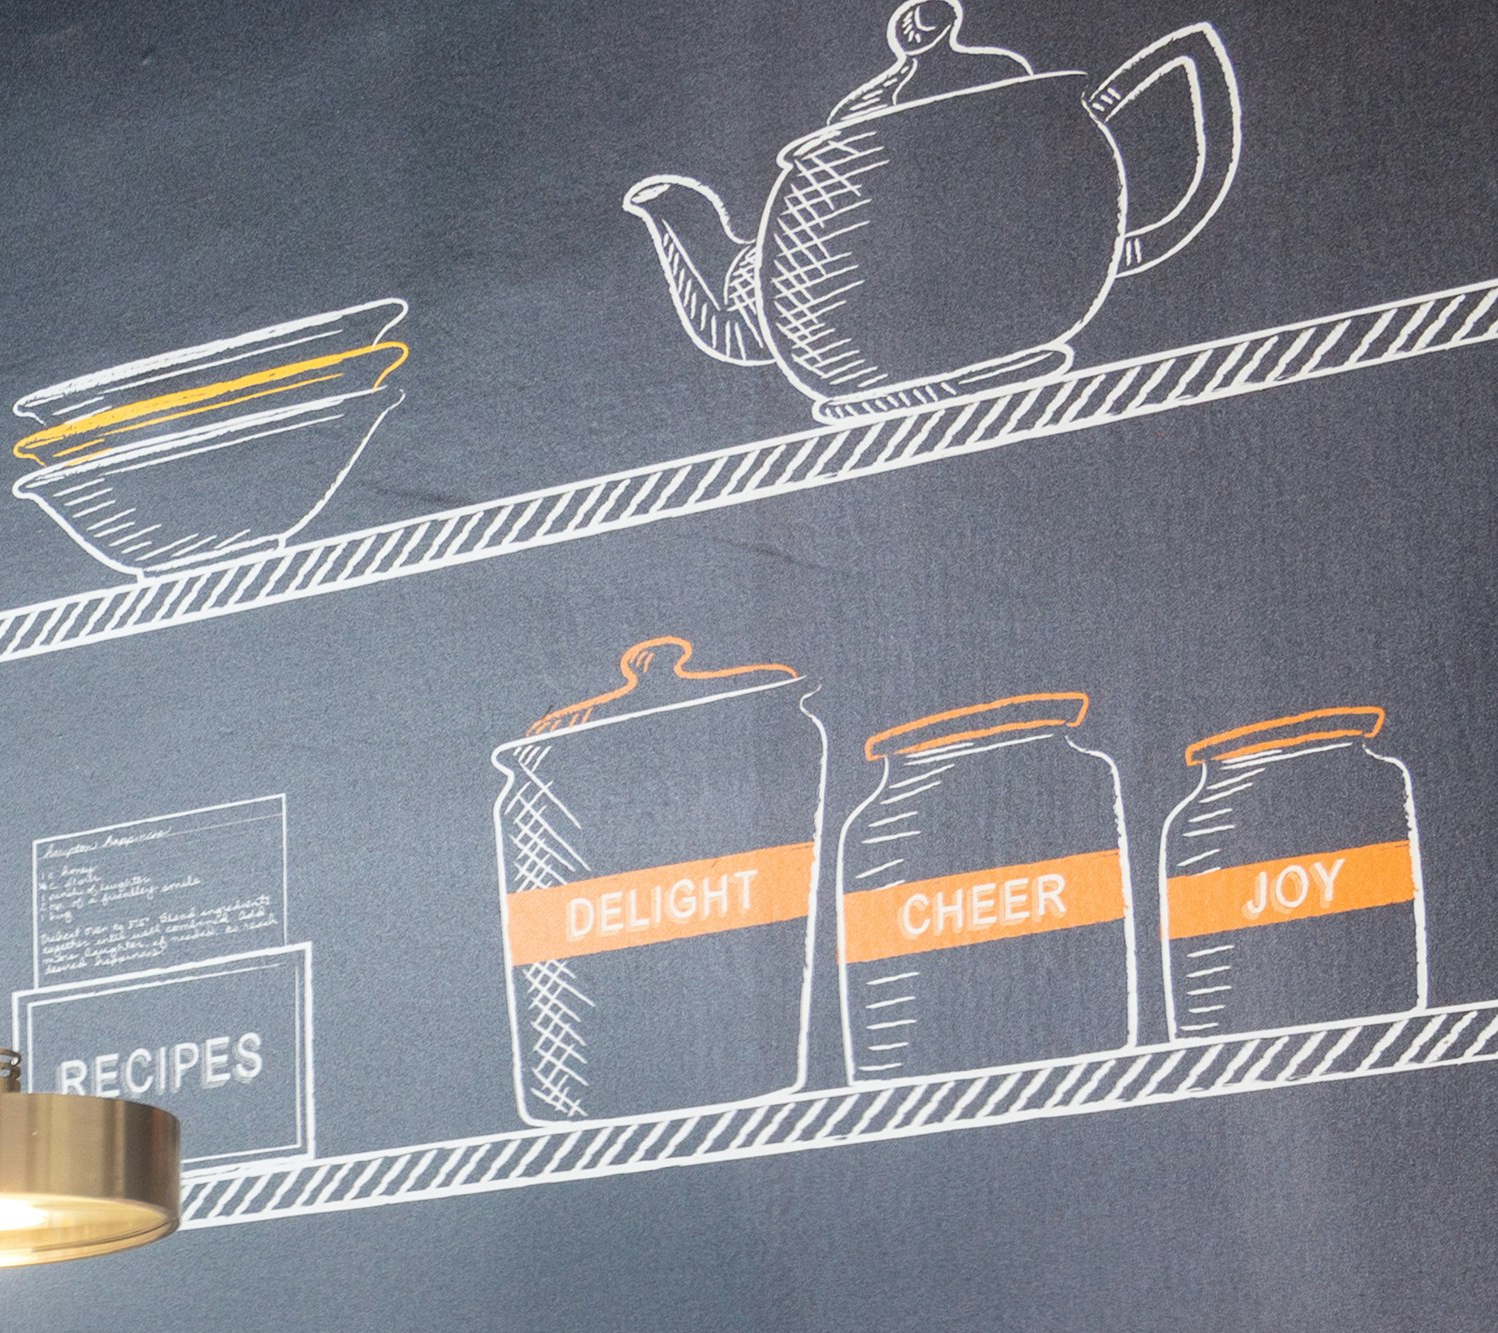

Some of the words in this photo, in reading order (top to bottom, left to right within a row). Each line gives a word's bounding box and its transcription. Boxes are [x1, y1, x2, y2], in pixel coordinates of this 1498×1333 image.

[566, 869, 758, 942] DELIGHT
[899, 873, 1068, 936] CHEER
[1242, 857, 1346, 919] JOY
[57, 1032, 262, 1097] RECIPES
